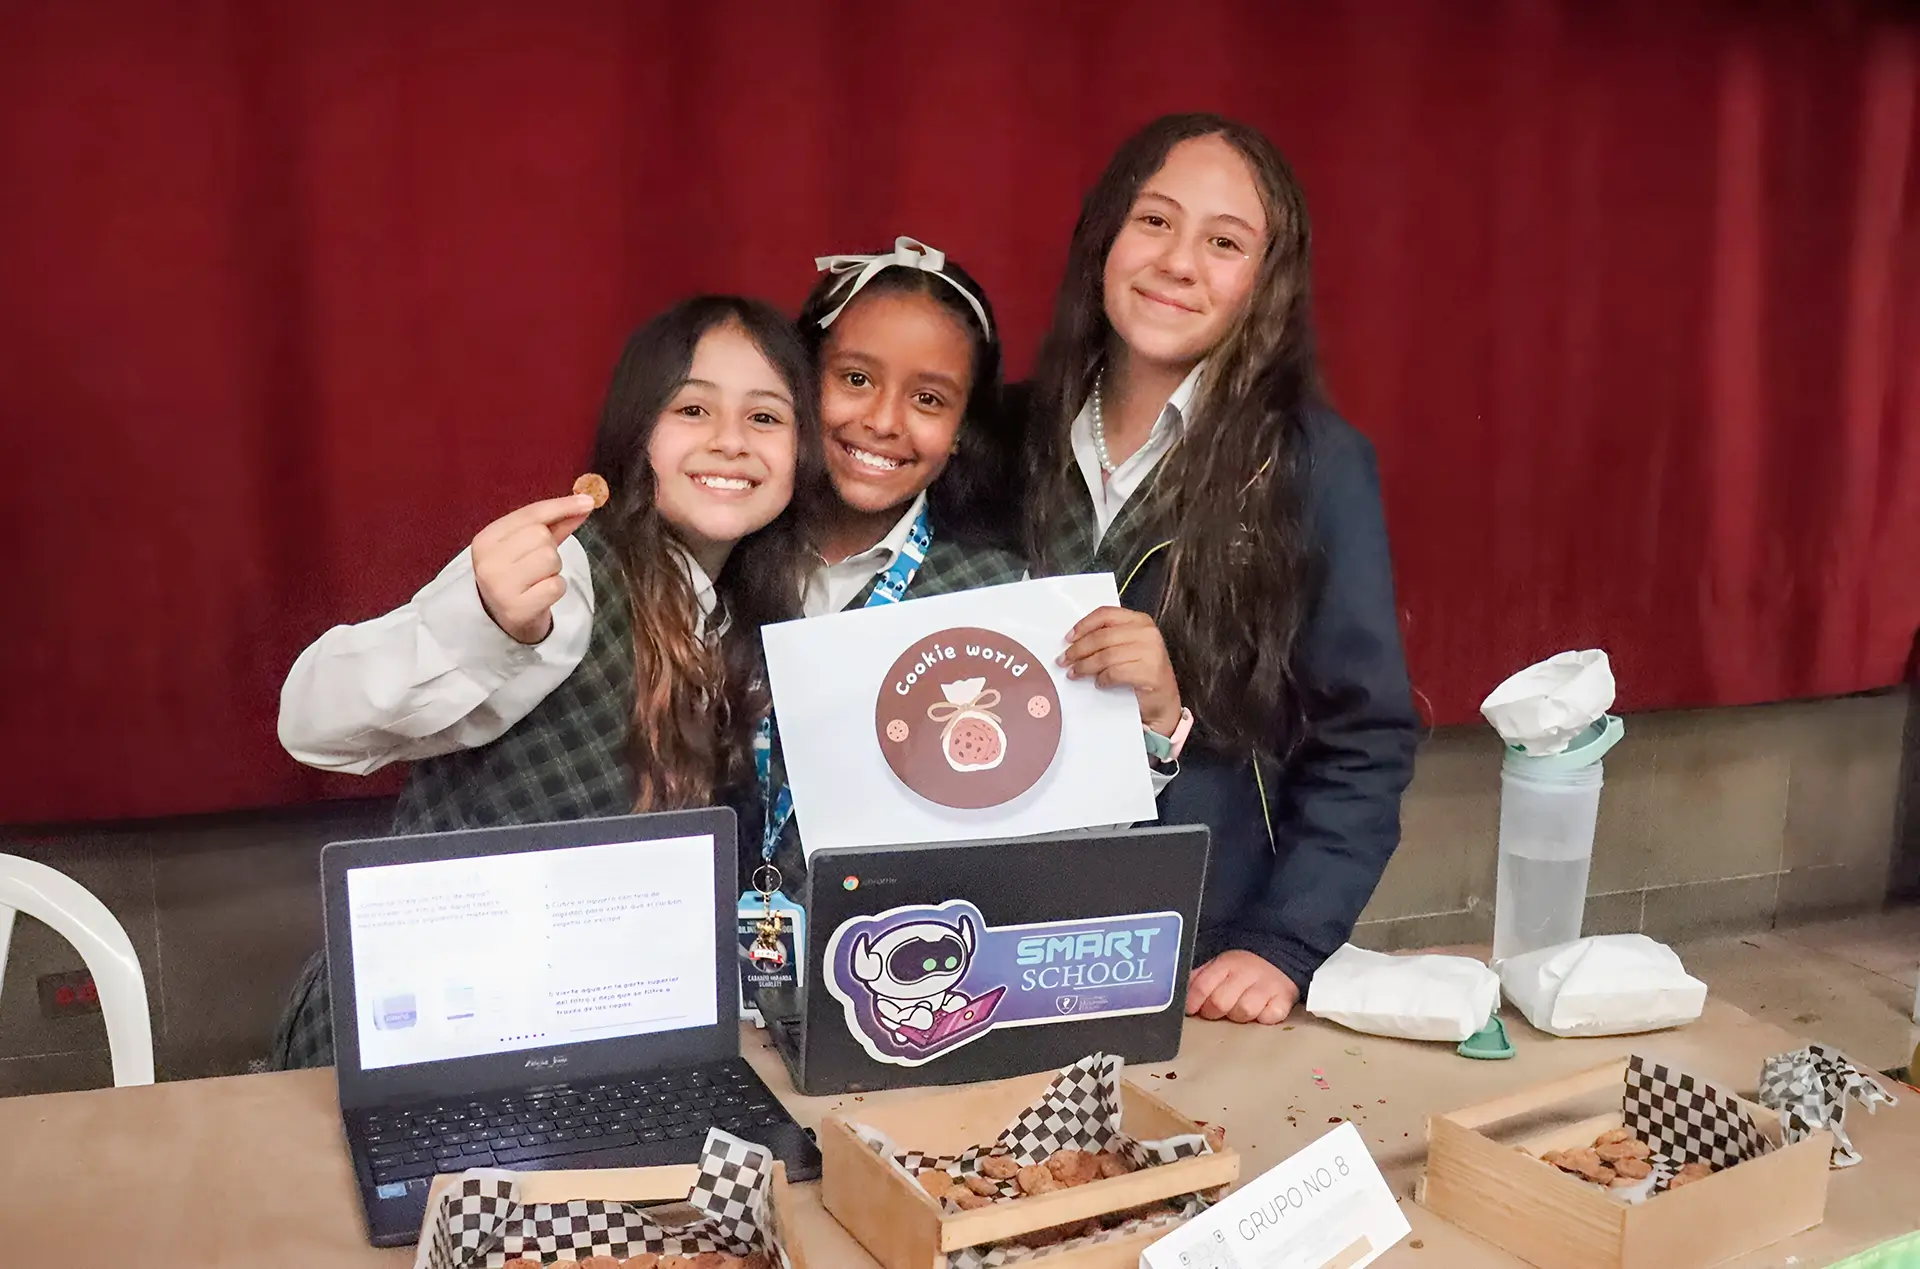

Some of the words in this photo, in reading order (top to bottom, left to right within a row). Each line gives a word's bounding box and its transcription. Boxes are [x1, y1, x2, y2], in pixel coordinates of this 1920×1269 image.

[896, 644, 957, 695] Cookie
[966, 644, 1028, 677] world
[1016, 928, 1161, 965] SMART
[1021, 958, 1153, 992] SCHOOL
[1238, 1186, 1303, 1241] GRUPO
[1308, 1167, 1338, 1199] NO.
[1334, 1155, 1350, 1177] 8
